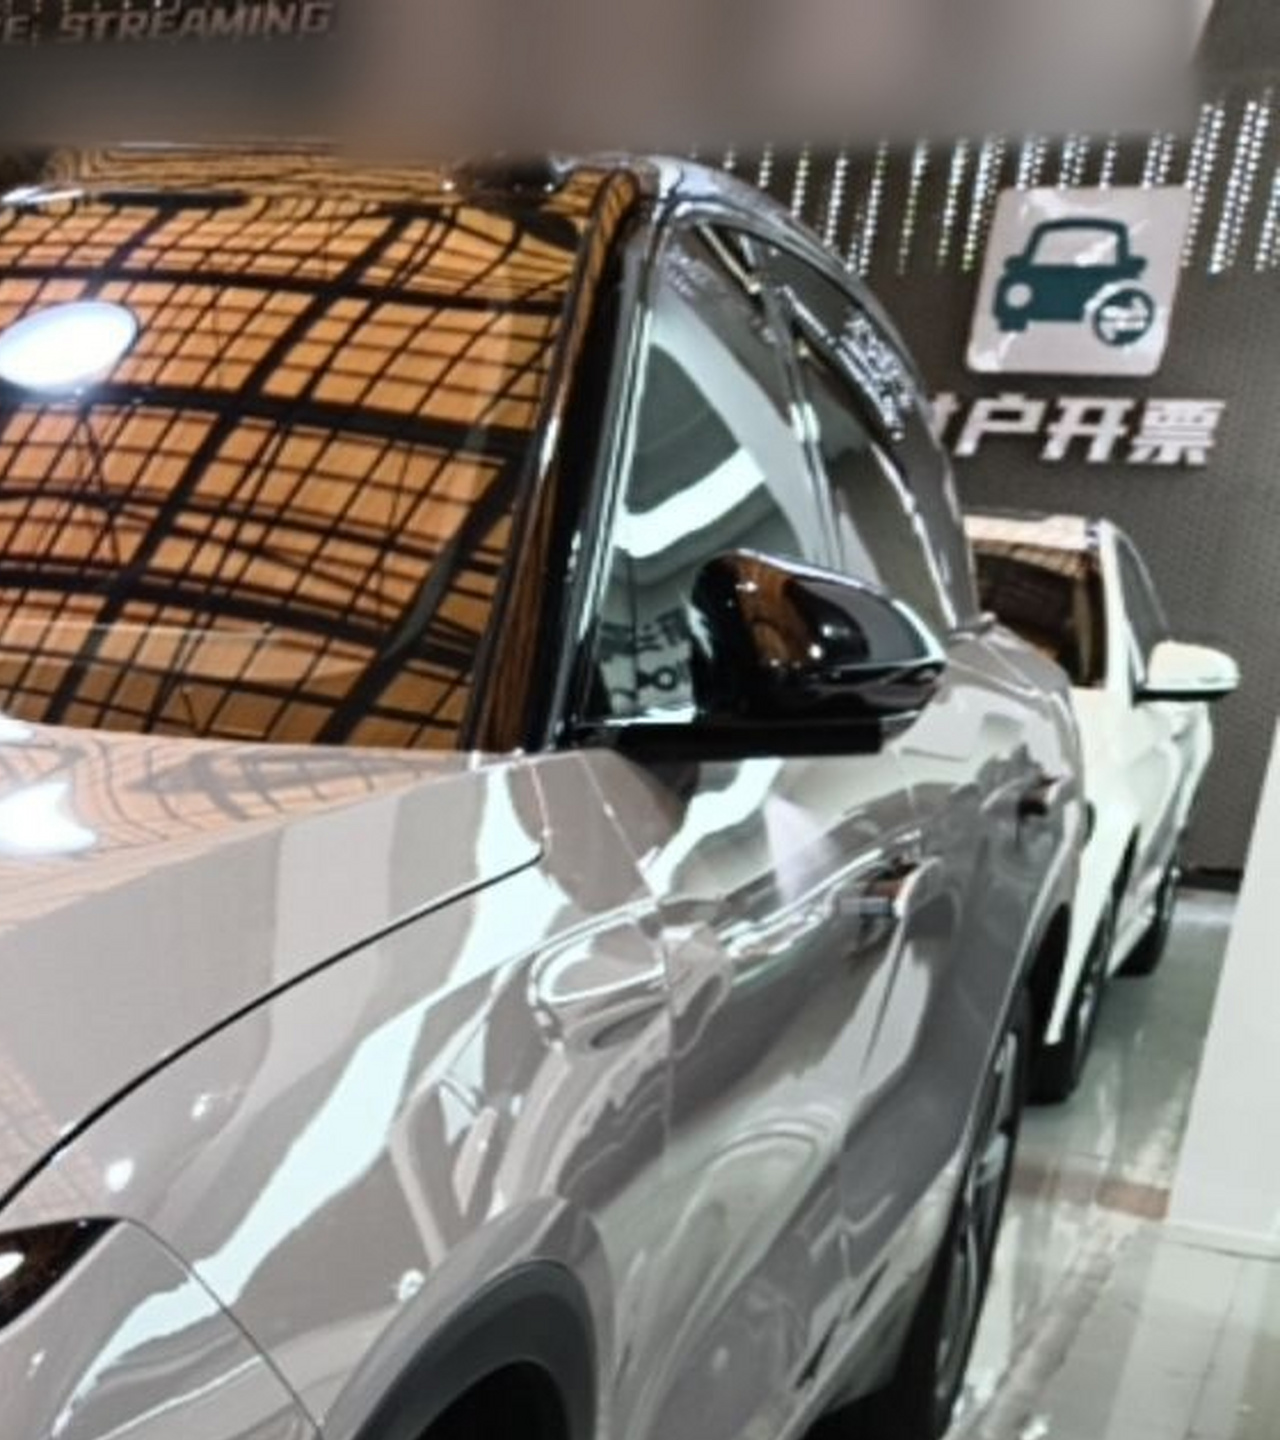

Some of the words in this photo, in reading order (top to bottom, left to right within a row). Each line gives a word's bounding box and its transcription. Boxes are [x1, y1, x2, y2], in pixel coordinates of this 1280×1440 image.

[57, 2, 333, 44] STREAMING
[928, 392, 1226, 466] 户开票
